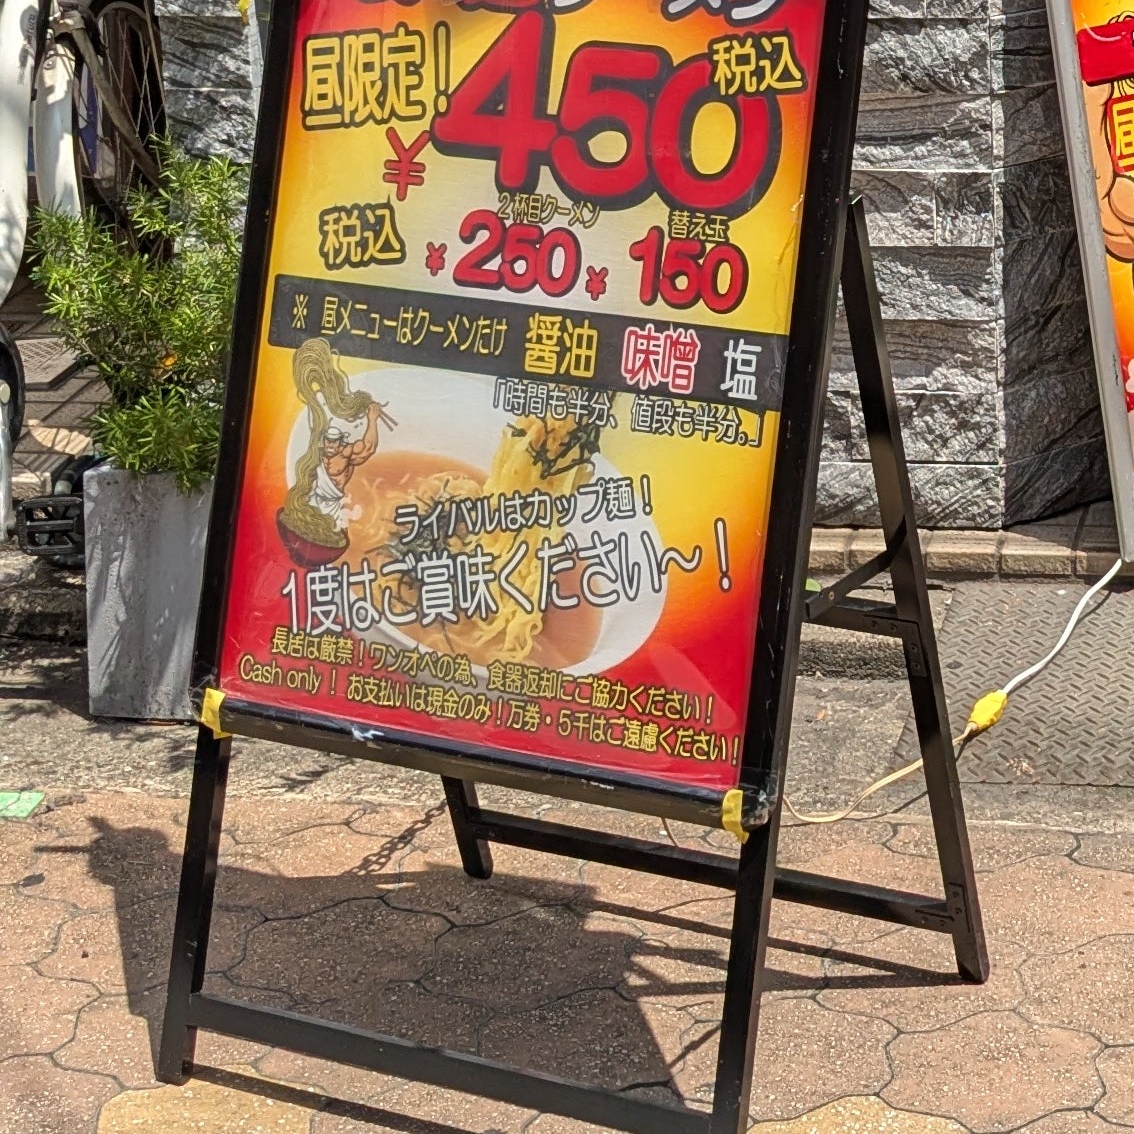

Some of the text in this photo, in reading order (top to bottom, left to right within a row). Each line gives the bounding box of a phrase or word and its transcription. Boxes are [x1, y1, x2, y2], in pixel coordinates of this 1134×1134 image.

[710, 34, 806, 96] 税込
[320, 202, 404, 268] 税込
[668, 210, 730, 244] 替え玉
[524, 312, 599, 379] 醤油
[621, 325, 701, 393] 味噌
[720, 338, 763, 401] 塩
[240, 654, 282, 686] Cash
[287, 666, 321, 695] only
